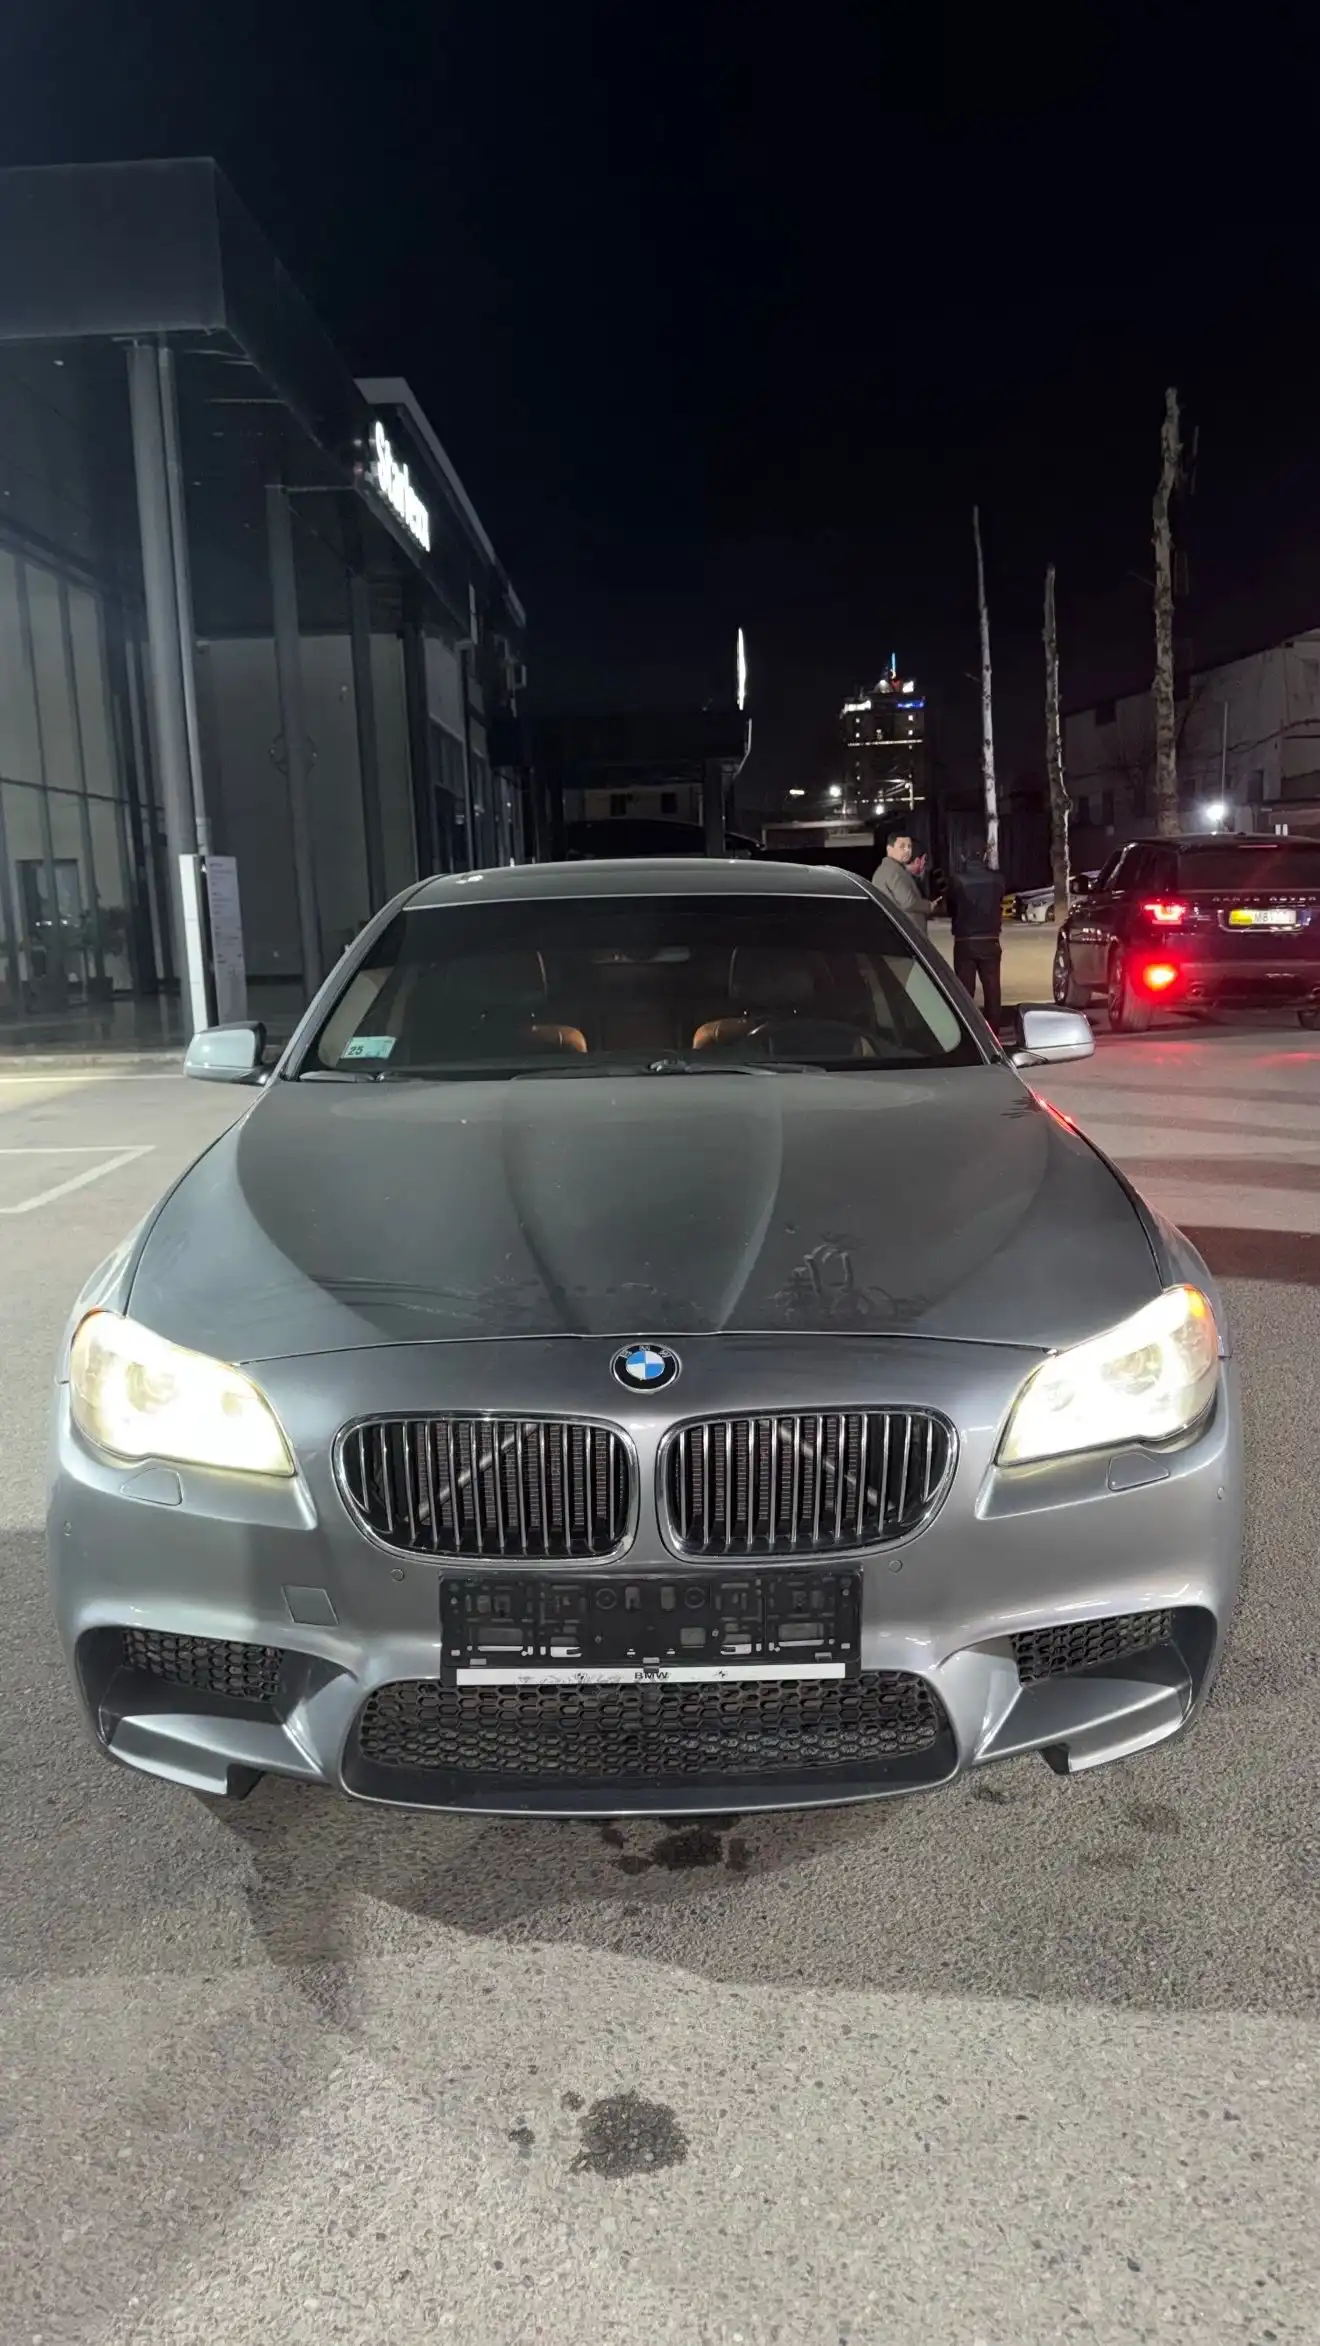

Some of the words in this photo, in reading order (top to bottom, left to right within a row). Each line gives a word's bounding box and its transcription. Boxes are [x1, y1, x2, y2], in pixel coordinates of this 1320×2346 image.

[349, 1045, 364, 1055] 25
[619, 1344, 672, 1358] BMW
[635, 1671, 669, 1679] BMW
